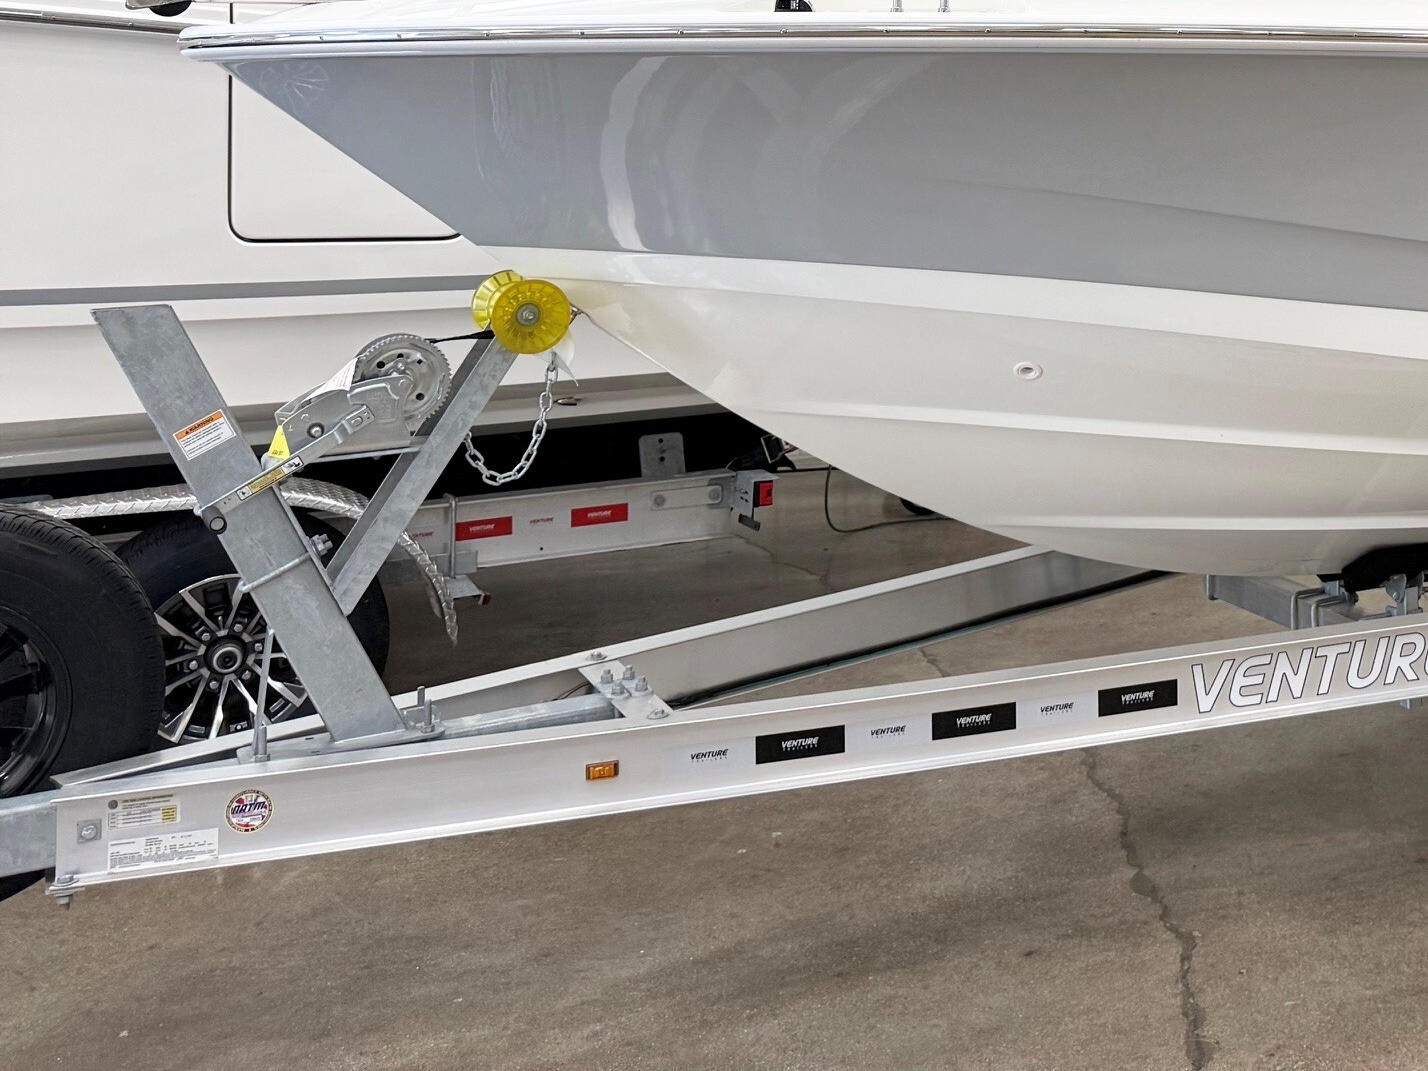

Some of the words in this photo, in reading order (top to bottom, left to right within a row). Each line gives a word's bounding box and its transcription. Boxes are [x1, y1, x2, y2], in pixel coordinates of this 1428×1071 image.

[1121, 690, 1155, 702] VENTURE
[1040, 702, 1074, 713] VENTURE
[956, 713, 992, 725] VENTURE
[870, 725, 906, 736] VENTURE
[781, 736, 819, 749] VENTURE
[690, 748, 729, 760] VENTURE
